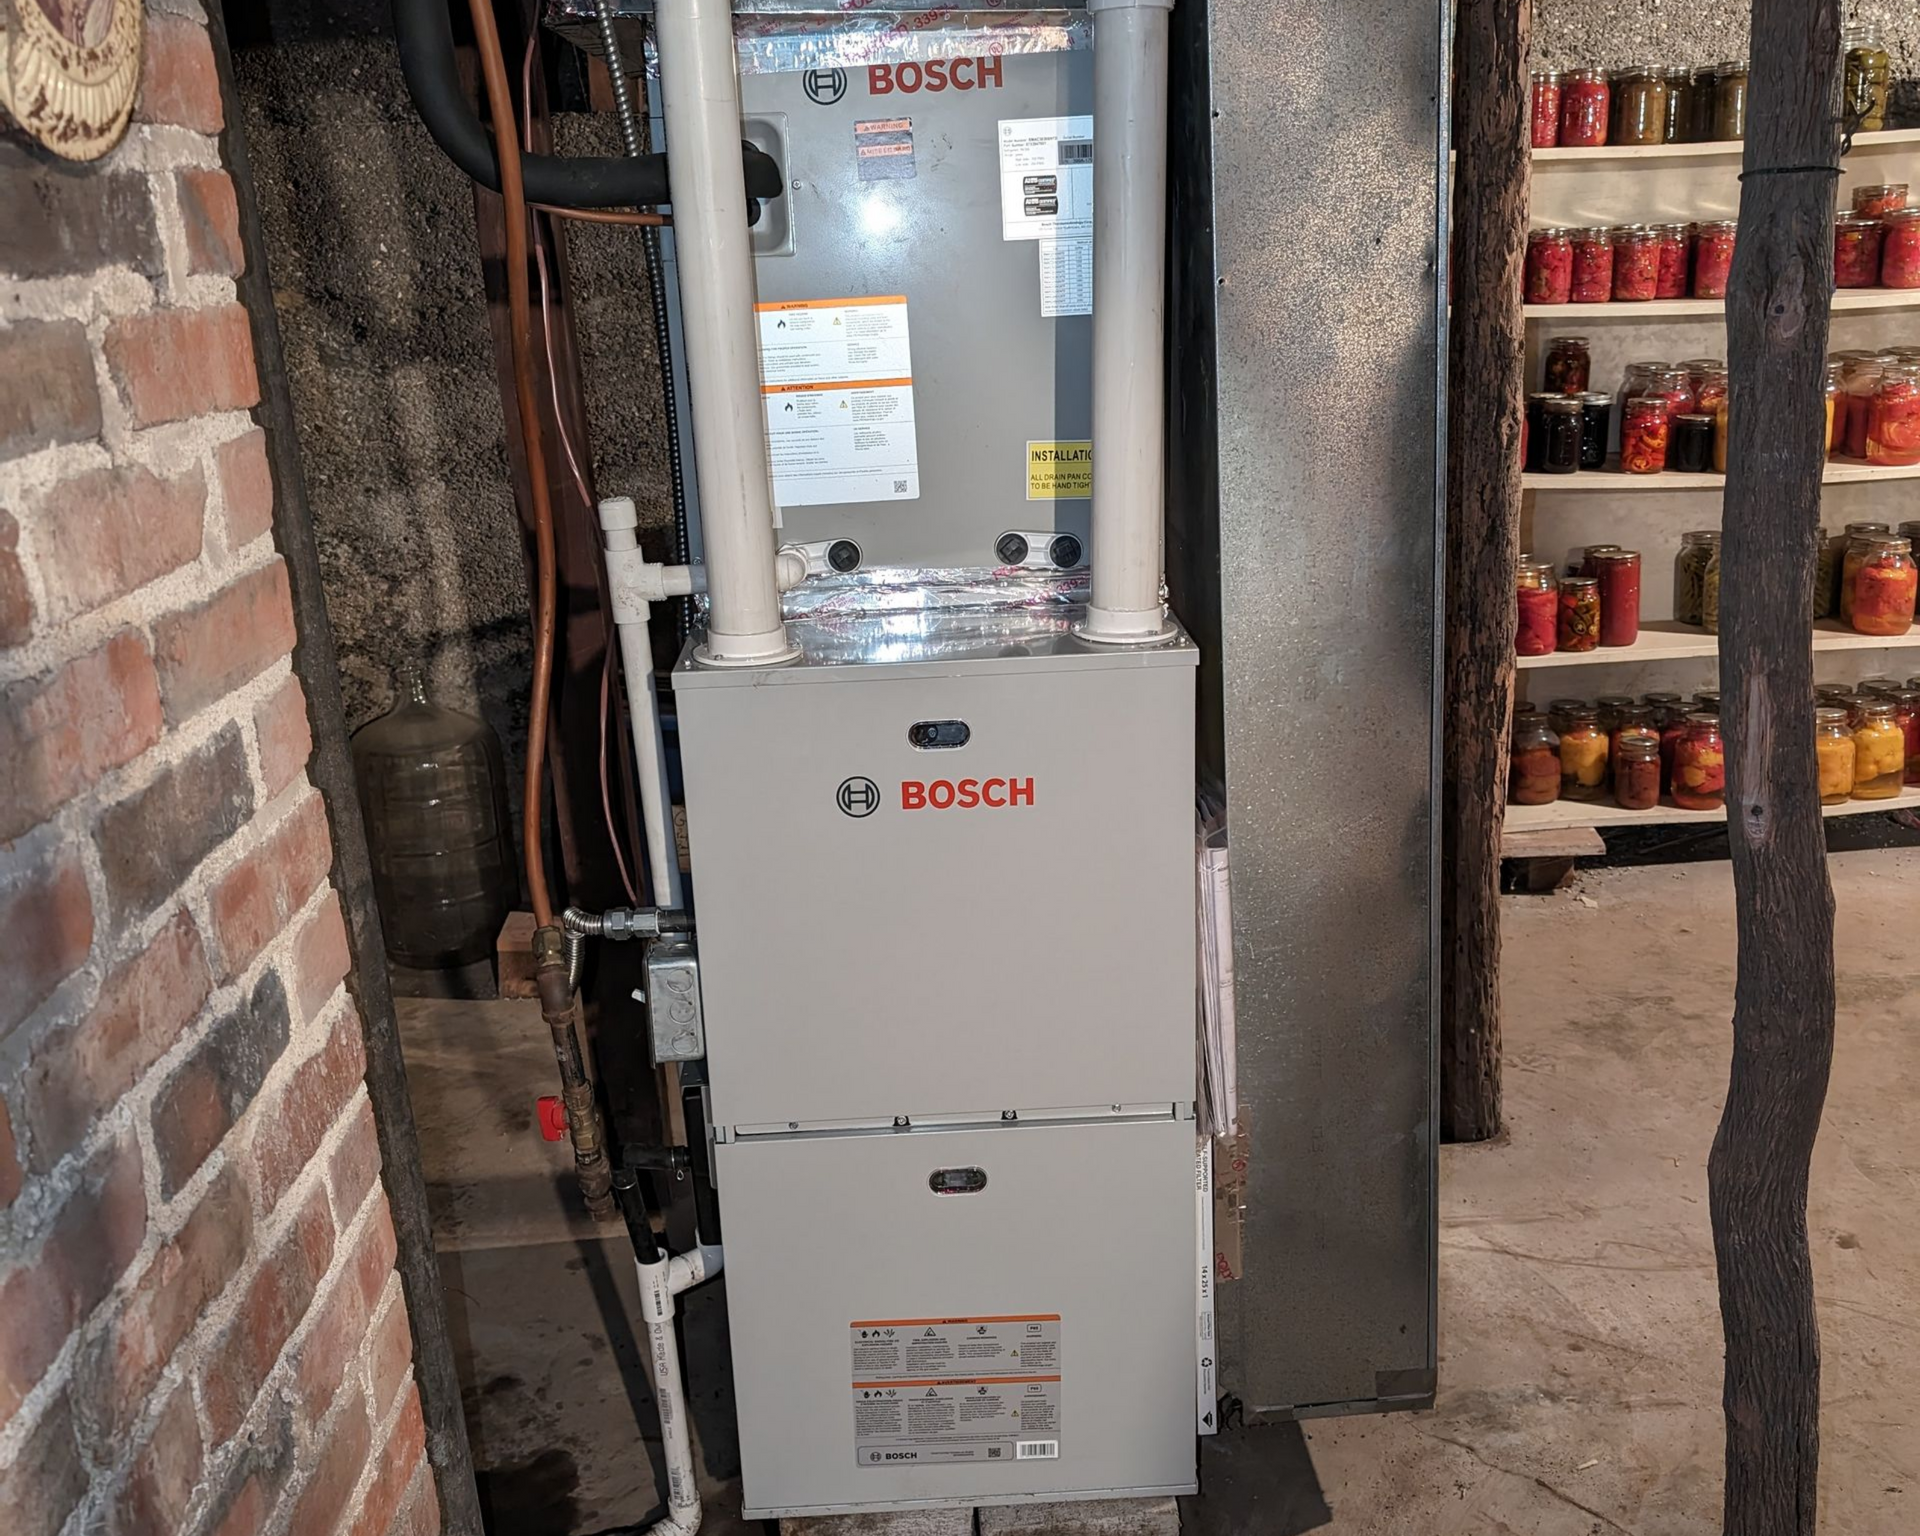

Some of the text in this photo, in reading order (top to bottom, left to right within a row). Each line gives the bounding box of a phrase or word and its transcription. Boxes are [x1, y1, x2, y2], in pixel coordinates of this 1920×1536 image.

[868, 56, 1003, 95] BOSCH
[871, 123, 904, 131] WARNING
[1044, 473, 1066, 481] DRAIN
[901, 777, 1035, 810] BOSCH
[1201, 1265, 1208, 1274] 14
[1201, 1280, 1208, 1289] 25
[659, 1362, 668, 1376] USA
[885, 1452, 917, 1460] BOSCH
